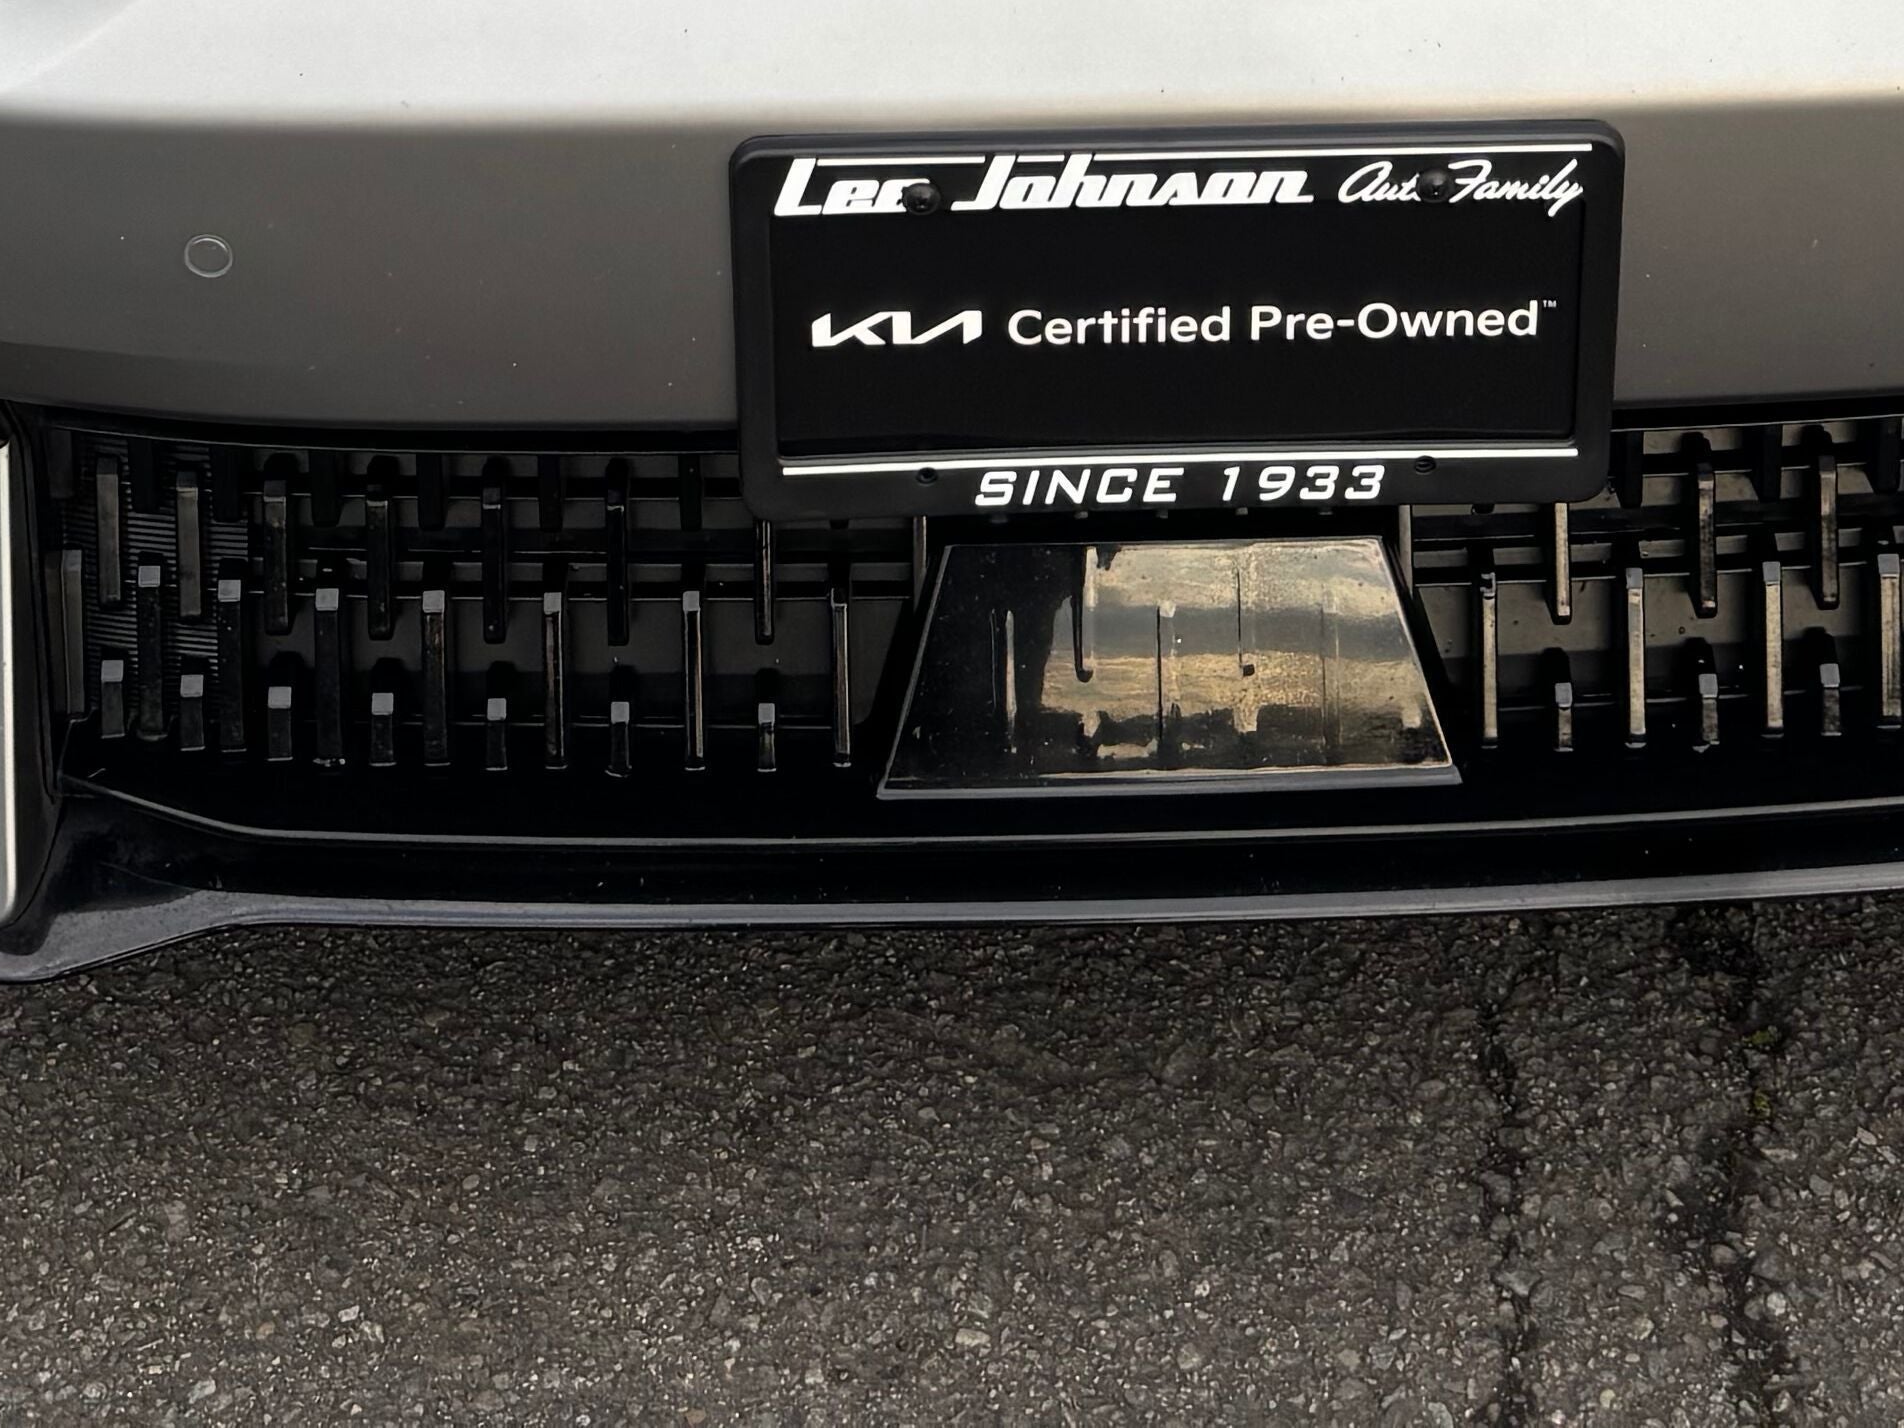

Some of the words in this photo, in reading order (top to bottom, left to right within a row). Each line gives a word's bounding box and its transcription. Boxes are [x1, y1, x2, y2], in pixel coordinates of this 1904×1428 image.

[951, 154, 1315, 211] Johnson
[1338, 161, 1424, 204] Aut
[1447, 158, 1584, 218] Family
[811, 310, 983, 348] KIA
[1007, 305, 1231, 346] Certified
[975, 468, 1185, 507] SINCE
[1222, 465, 1385, 502] 1933
